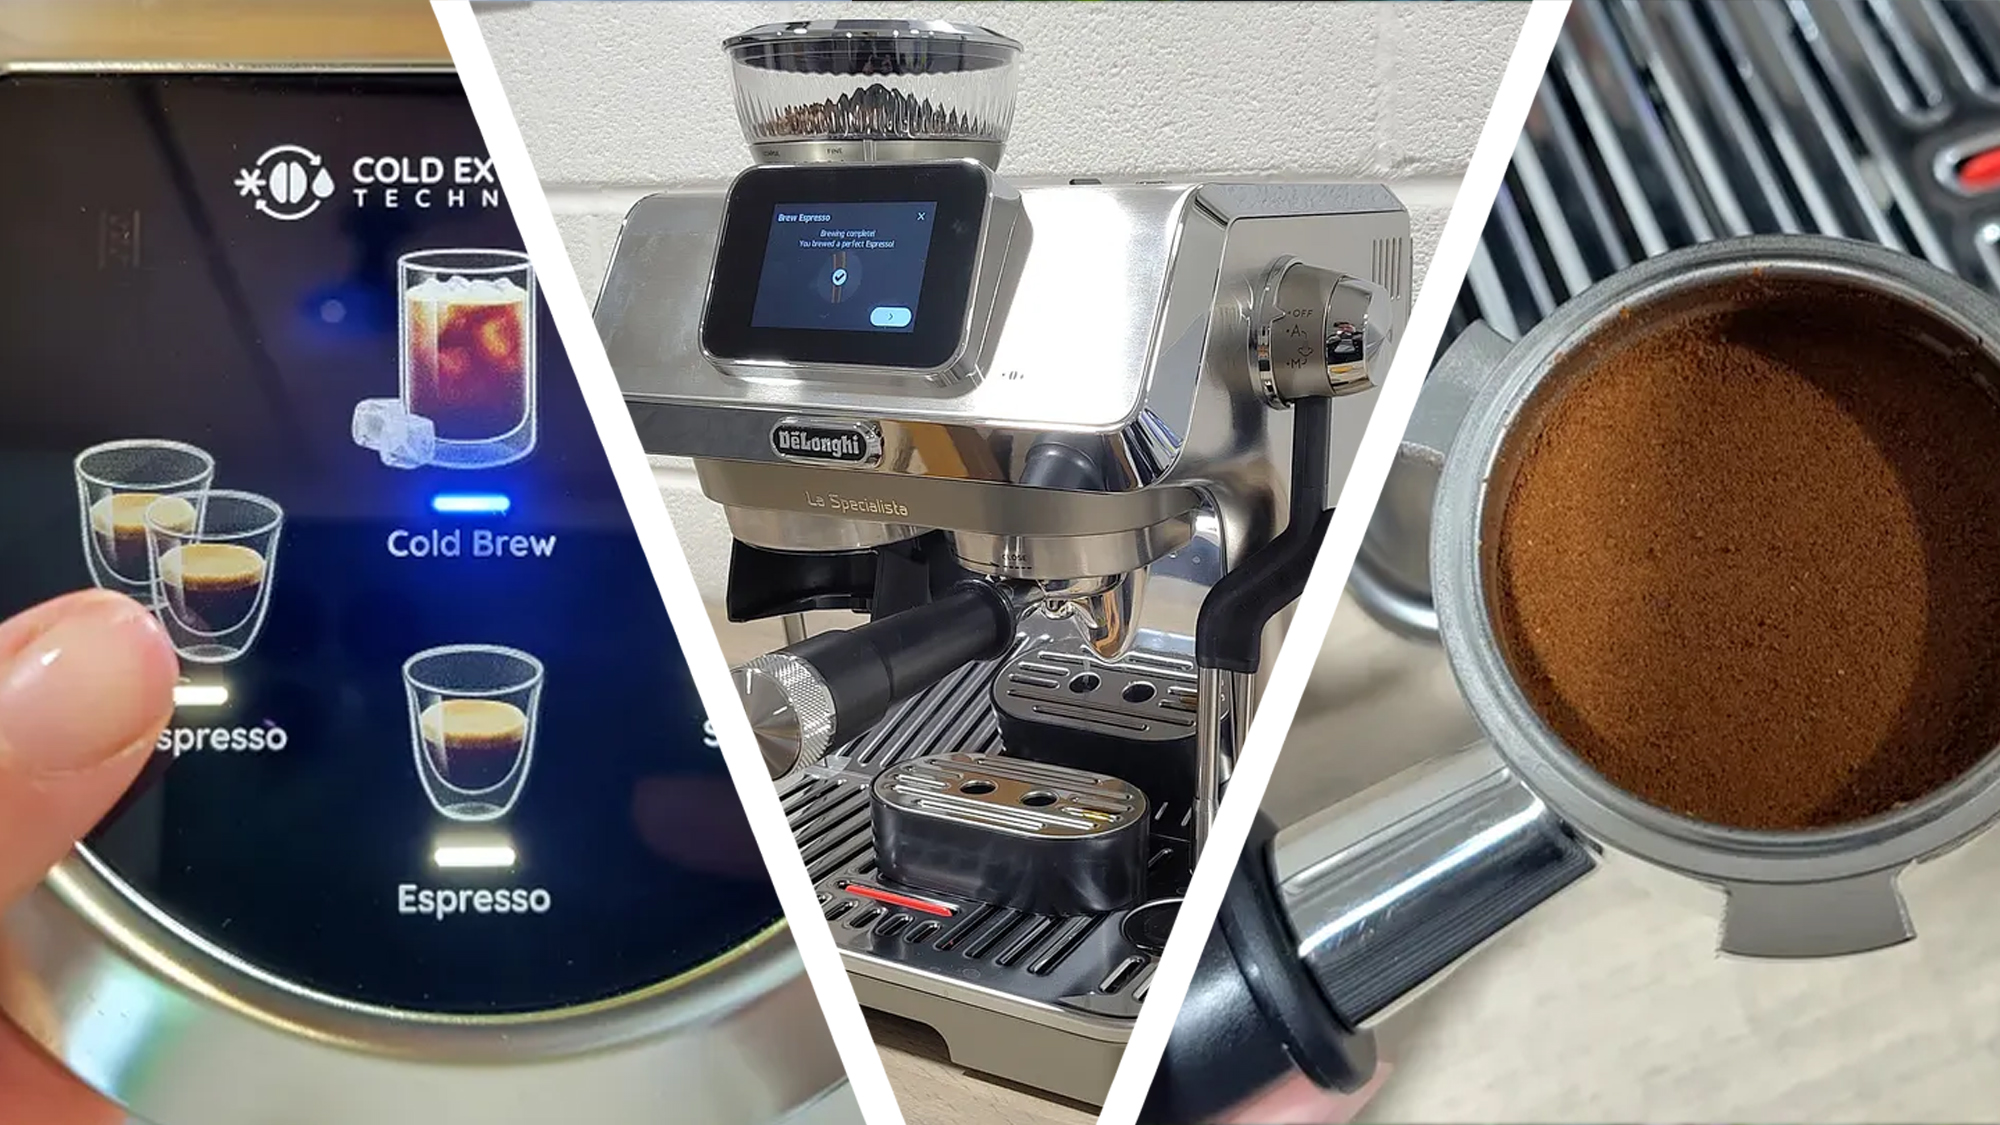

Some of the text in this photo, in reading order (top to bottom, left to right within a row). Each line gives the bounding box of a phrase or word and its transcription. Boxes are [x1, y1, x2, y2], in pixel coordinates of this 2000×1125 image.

[353, 156, 495, 183] COLD EX
[353, 189, 499, 208] TECHN
[778, 213, 831, 224] Brew Espresso
[820, 229, 845, 239] Brewing
[799, 240, 811, 248] You
[812, 240, 835, 248] brewed
[841, 240, 865, 249] perfect
[865, 240, 895, 249] Espresso!
[1293, 309, 1313, 317] OFF
[1290, 324, 1300, 337] A
[804, 491, 909, 516] La Specialista
[387, 528, 557, 557] Cold Brew
[155, 726, 288, 757] spresso
[398, 884, 551, 921] Espresso
